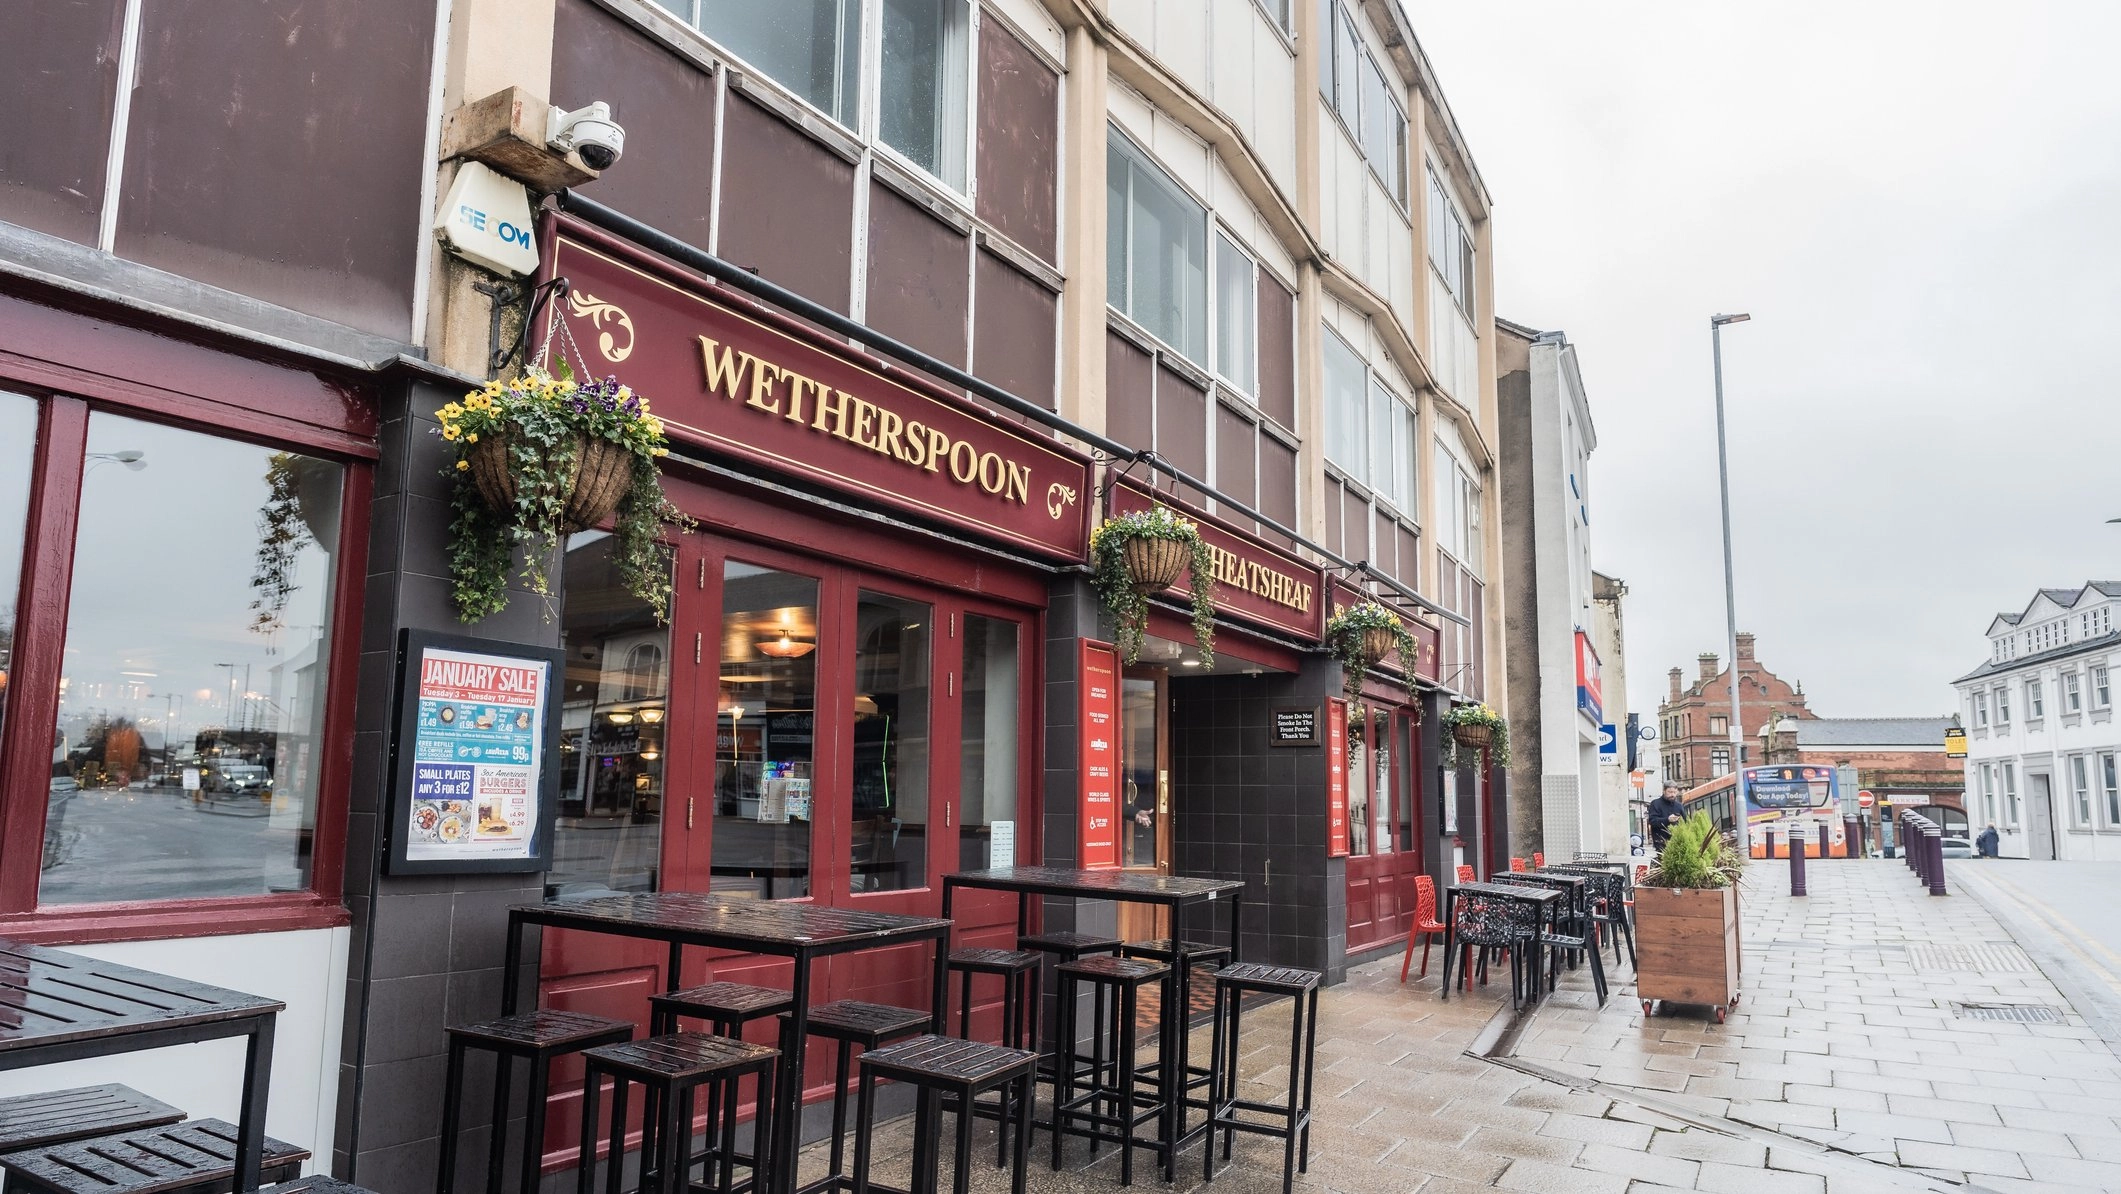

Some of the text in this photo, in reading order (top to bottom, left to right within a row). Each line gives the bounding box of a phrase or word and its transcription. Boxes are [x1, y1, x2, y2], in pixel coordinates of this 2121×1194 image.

[698, 334, 1032, 505] WETHERSPOON
[1199, 541, 1312, 613] HEATSHEAF
[423, 660, 537, 694] JANUARY SALE
[423, 688, 455, 699] Tuesday
[467, 692, 497, 702] Tuesday
[506, 695, 535, 705] January
[419, 768, 471, 781] SMALL PLATES
[480, 777, 527, 788] BURGERS
[418, 781, 470, 795] ANY 3 FOR £12
